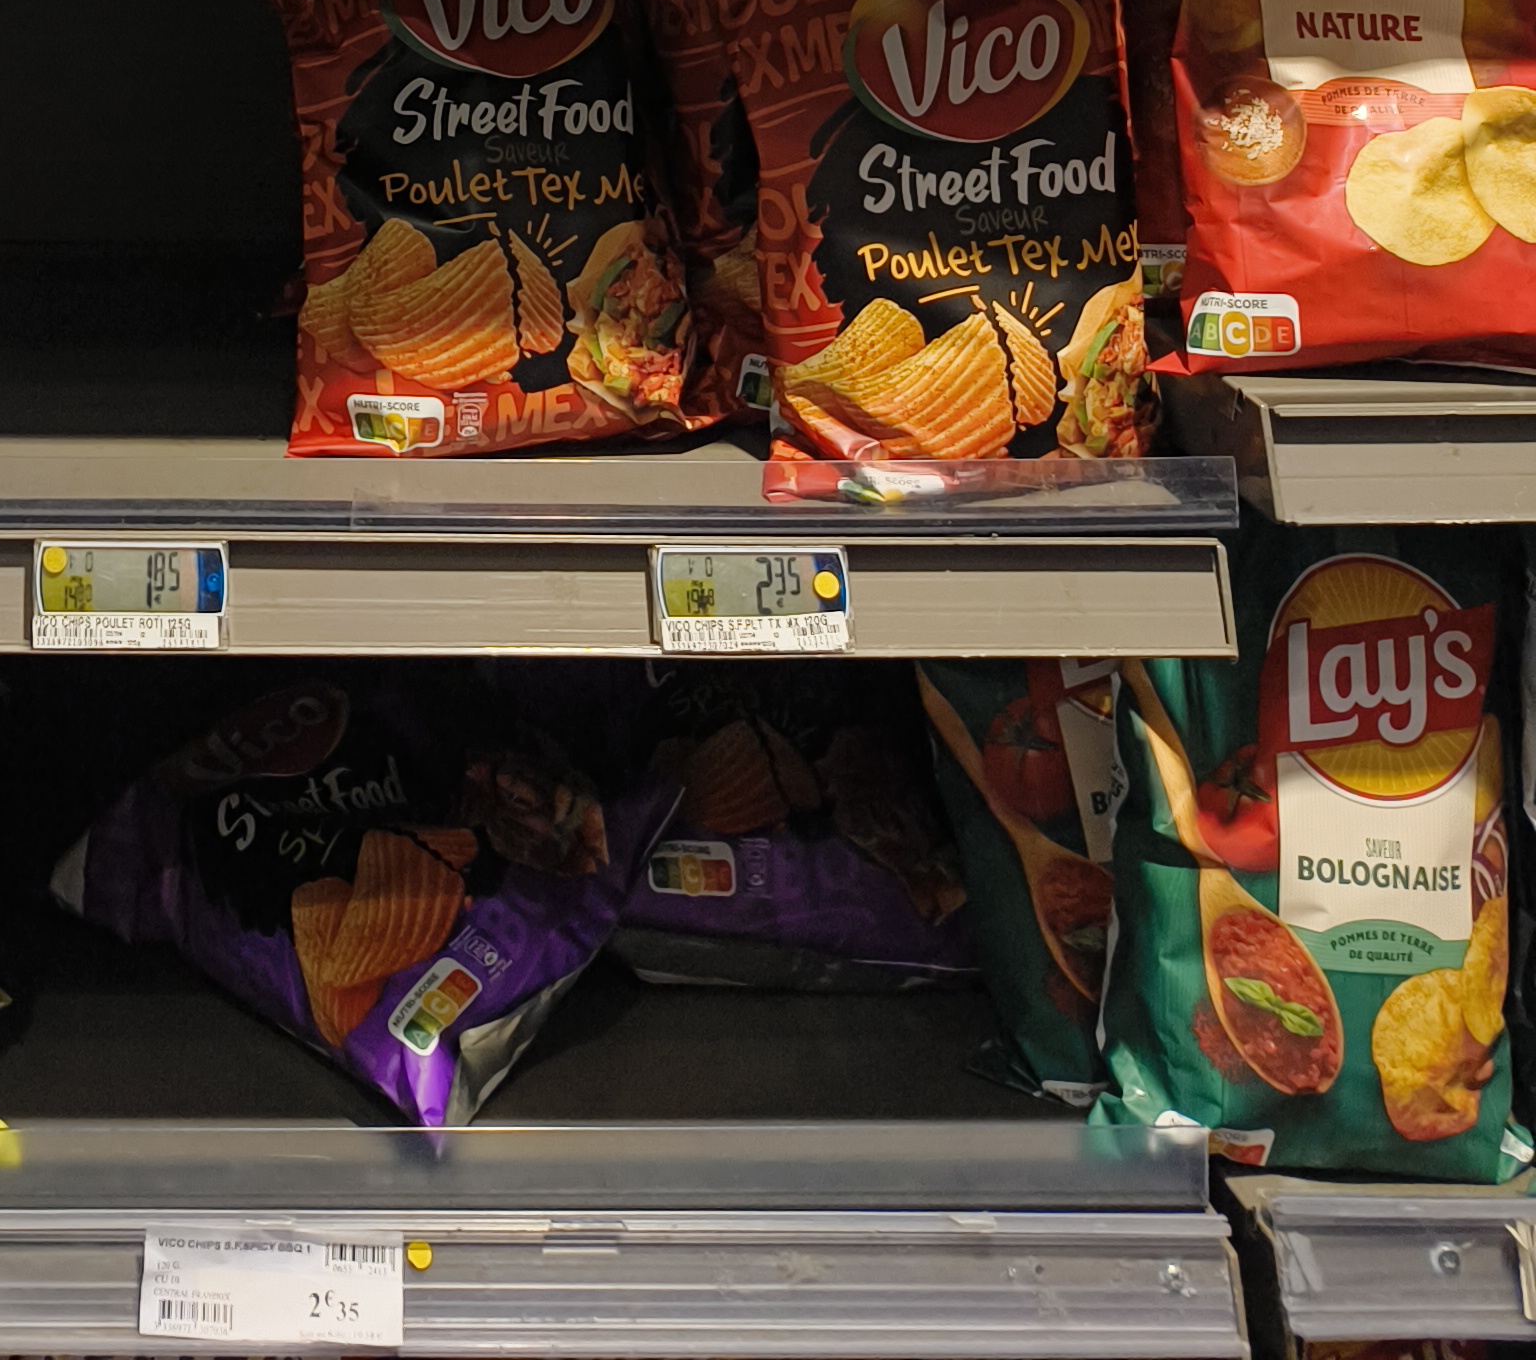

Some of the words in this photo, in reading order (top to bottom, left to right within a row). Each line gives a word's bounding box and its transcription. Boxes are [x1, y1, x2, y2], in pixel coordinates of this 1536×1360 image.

[1295, 11, 1423, 43] NATURE
[860, 143, 1008, 214] Street
[1009, 131, 1117, 198] Food
[955, 205, 1048, 236] Saveur
[858, 231, 992, 284] Poulet
[997, 234, 1069, 279] Tex
[353, 399, 421, 413] NUTRI-SCORE
[61, 618, 91, 628] CHIPS
[96, 618, 134, 629] POULET
[666, 620, 691, 631] VICO
[695, 620, 724, 631] CHIPS
[1287, 607, 1478, 745] Lay's
[1297, 856, 1463, 893] BOLOGNAISE
[1331, 929, 1380, 951] POMMES
[1382, 931, 1399, 942] DE
[1401, 932, 1435, 957] TERRE
[1349, 951, 1363, 962] DE
[1365, 949, 1413, 964] QUALITÉ
[158, 1238, 185, 1248] VICO
